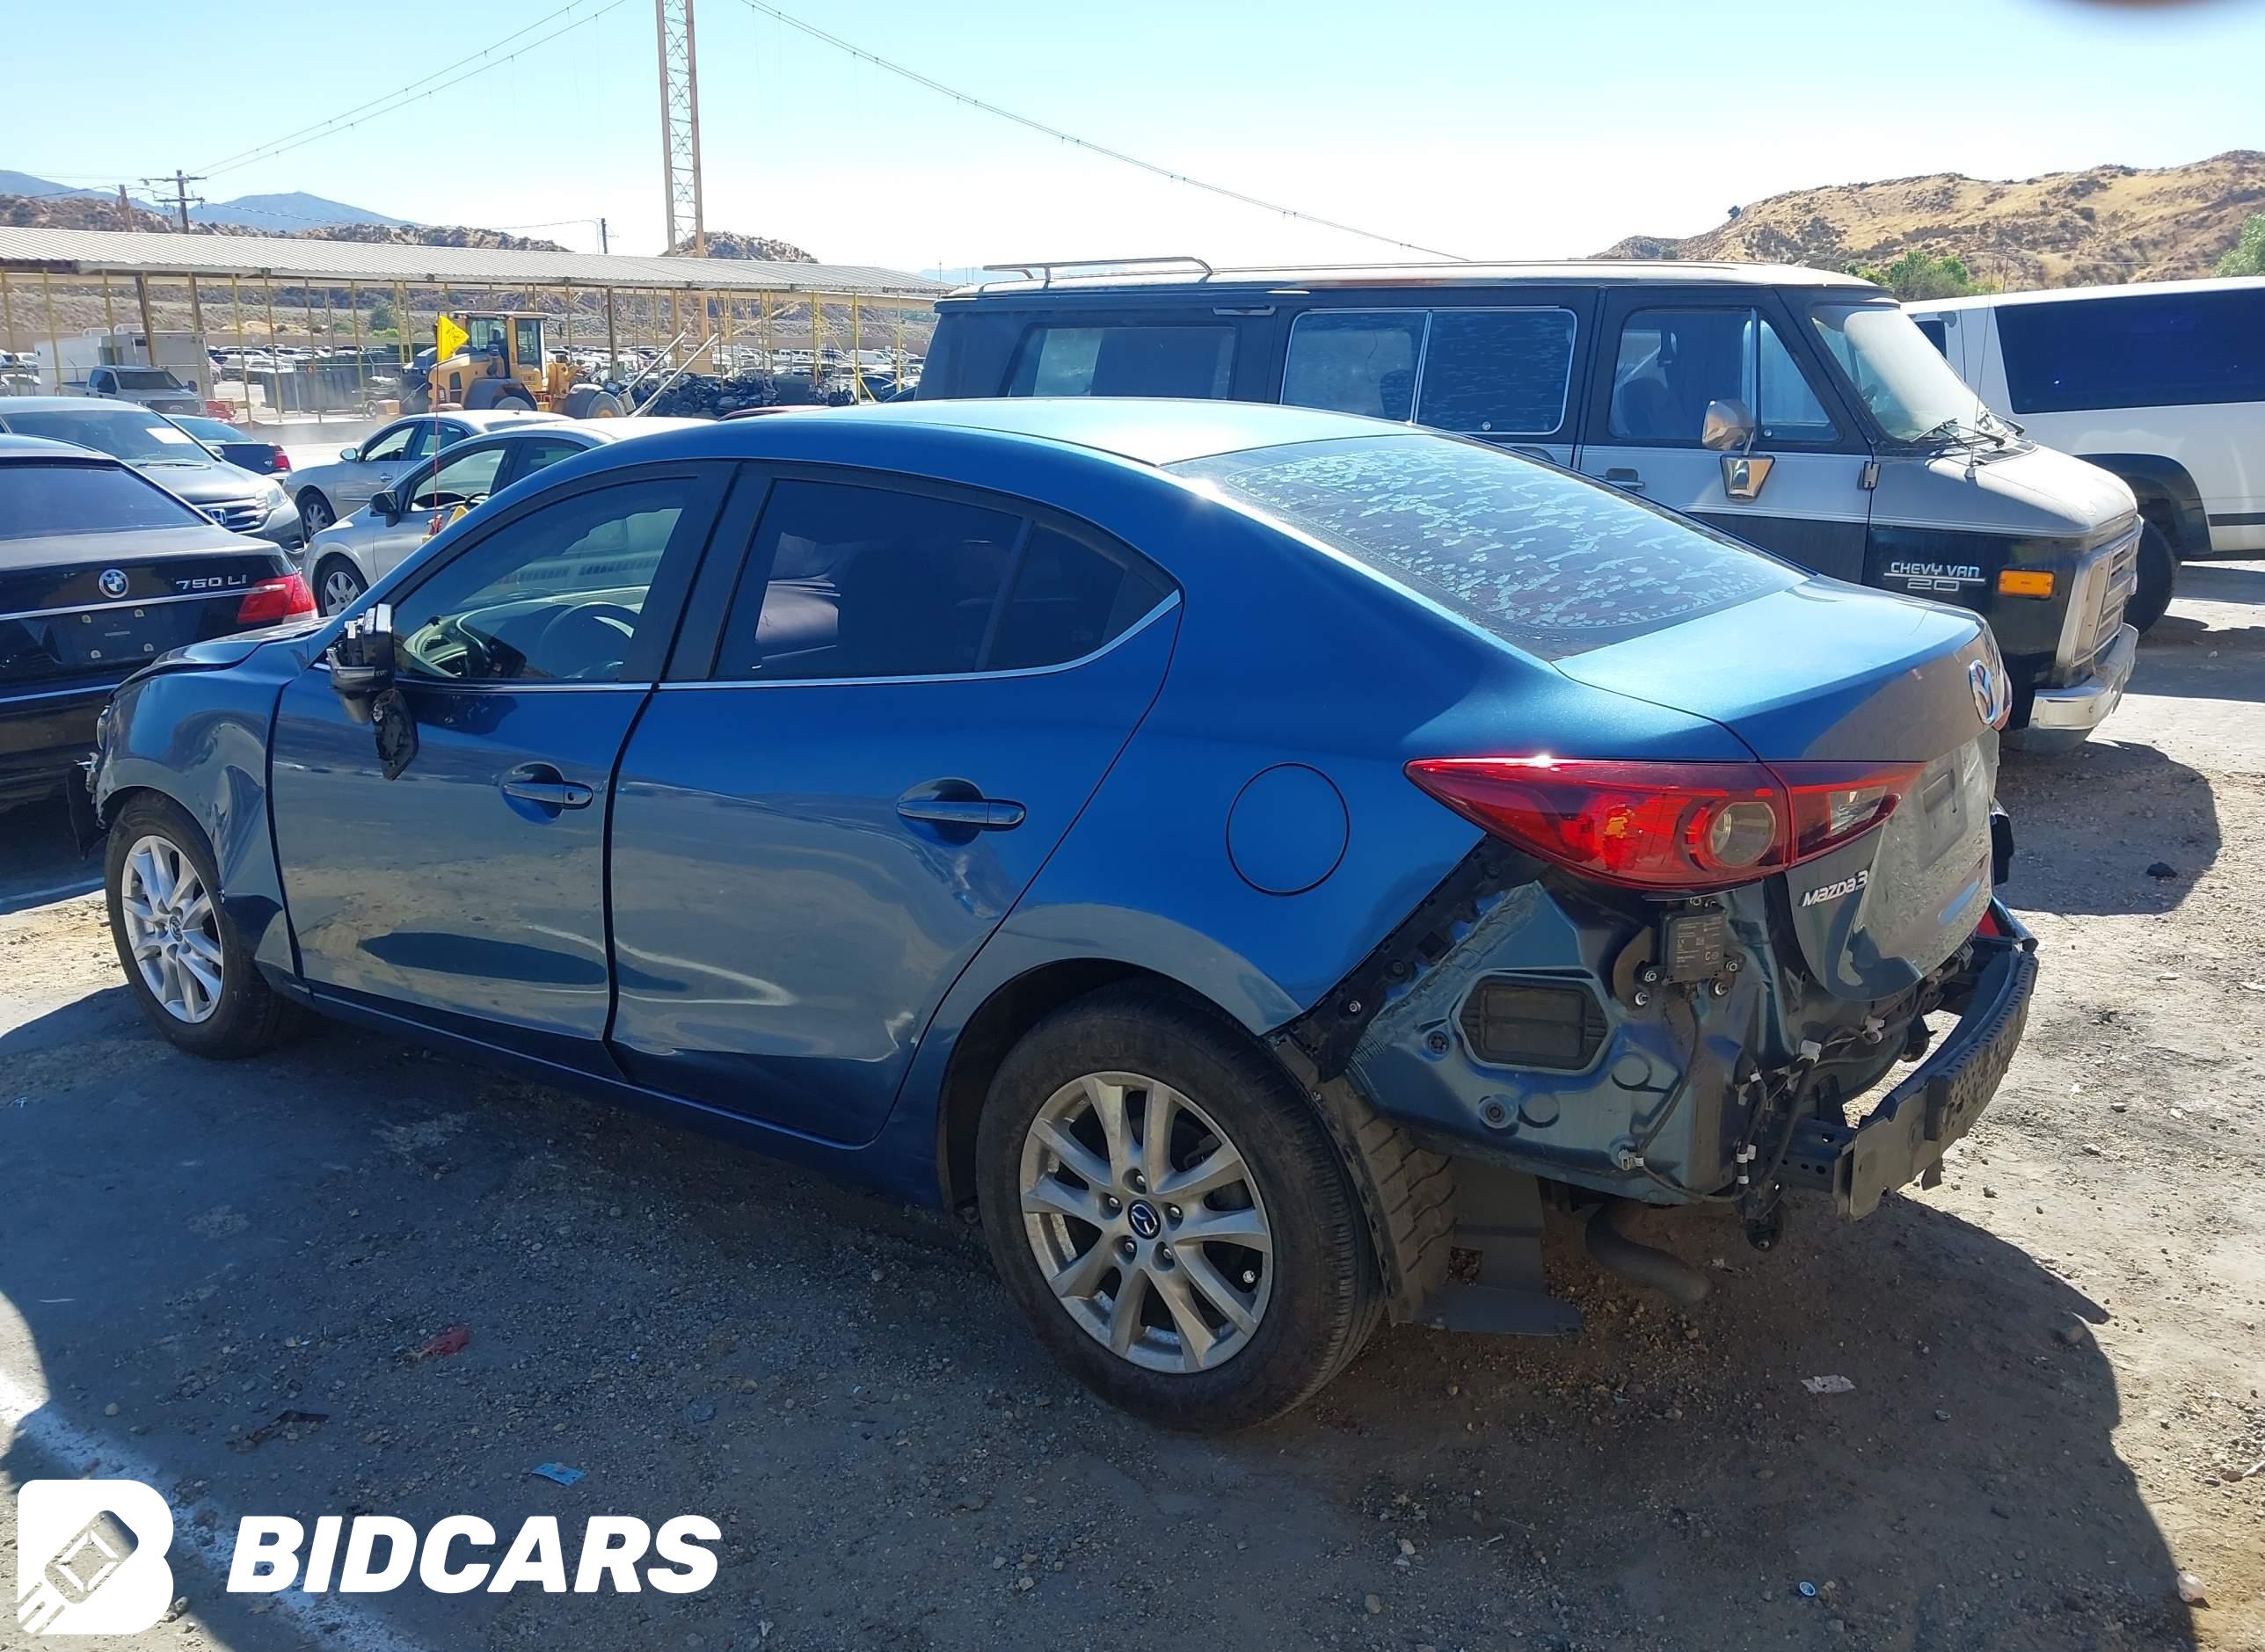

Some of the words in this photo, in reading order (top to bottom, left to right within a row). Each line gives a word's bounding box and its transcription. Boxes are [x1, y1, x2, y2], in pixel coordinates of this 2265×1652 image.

[1890, 562, 1942, 576] CHEVY
[1947, 564, 1980, 578] VAN
[176, 577, 222, 590] 750
[1907, 578, 1960, 591] 20
